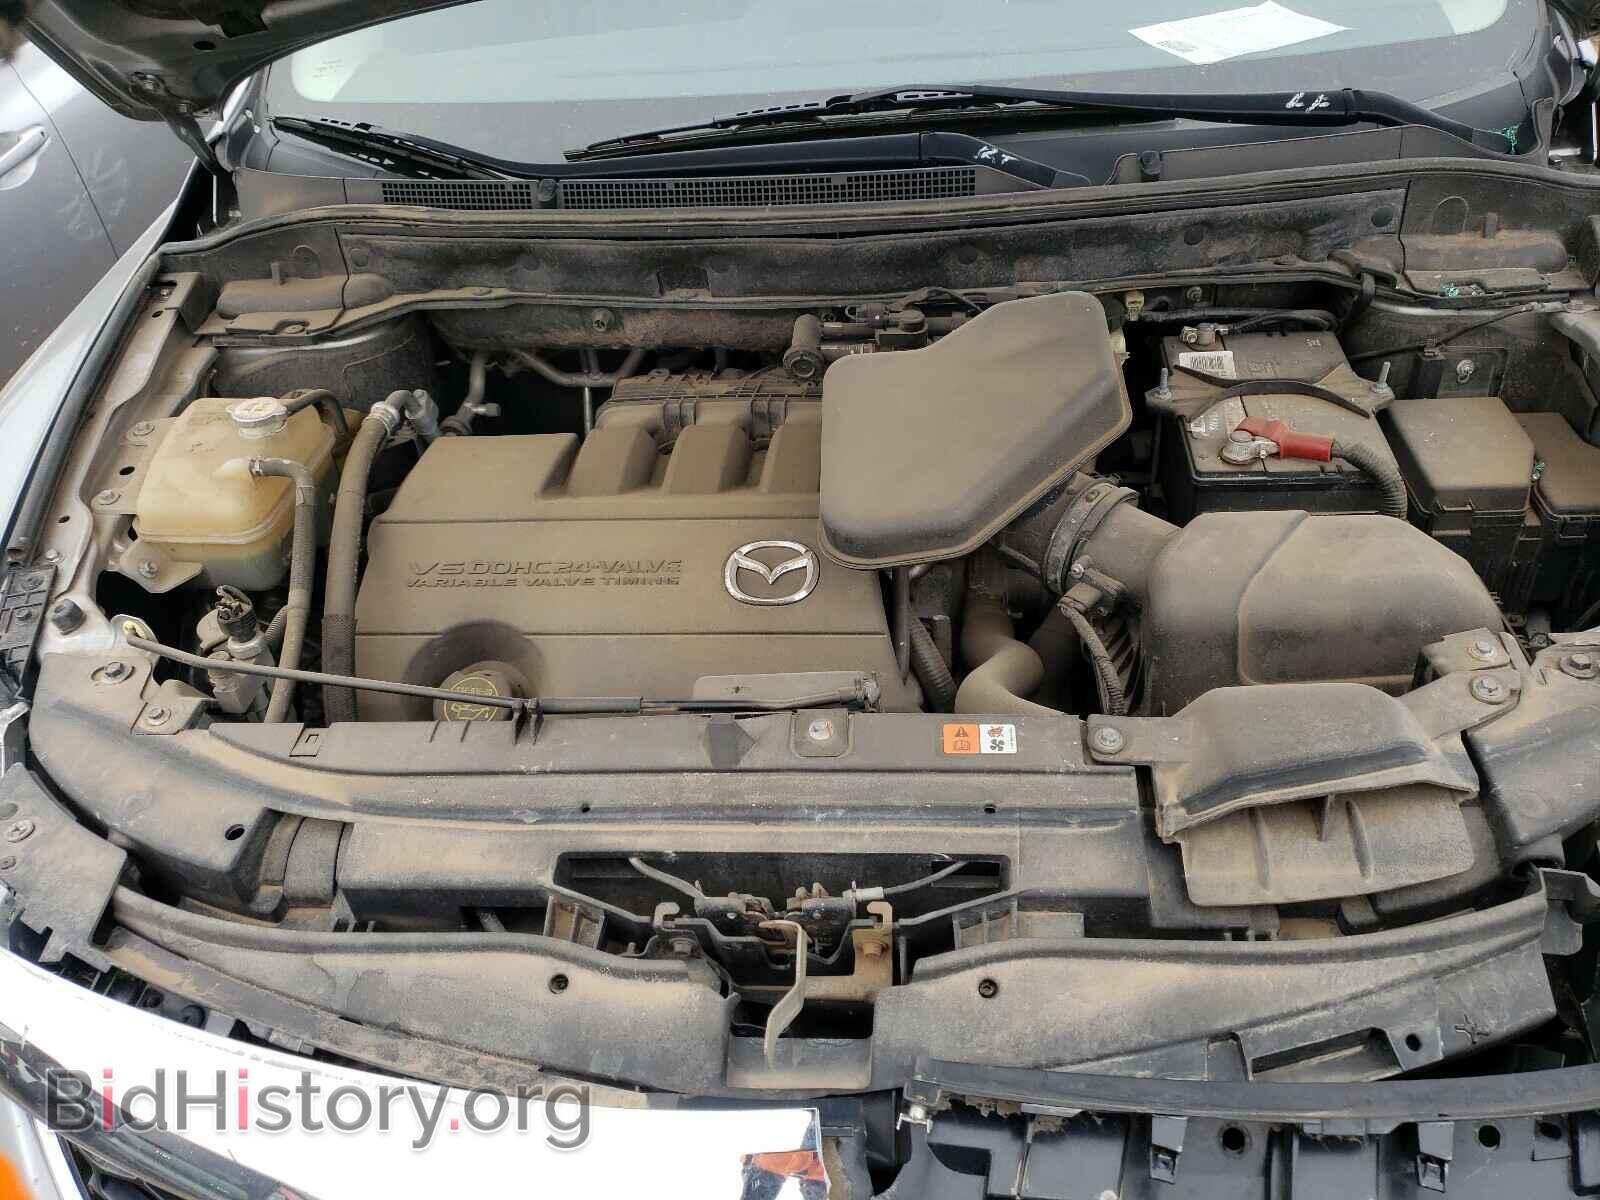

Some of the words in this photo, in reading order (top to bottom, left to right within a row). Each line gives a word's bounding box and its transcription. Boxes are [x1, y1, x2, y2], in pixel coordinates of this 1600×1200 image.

[467, 560, 553, 575] DOHC
[554, 560, 682, 574] 24-VALVE
[408, 578, 518, 588] VARIABLE
[527, 577, 596, 588] VALVE
[600, 576, 680, 586] TIMING
